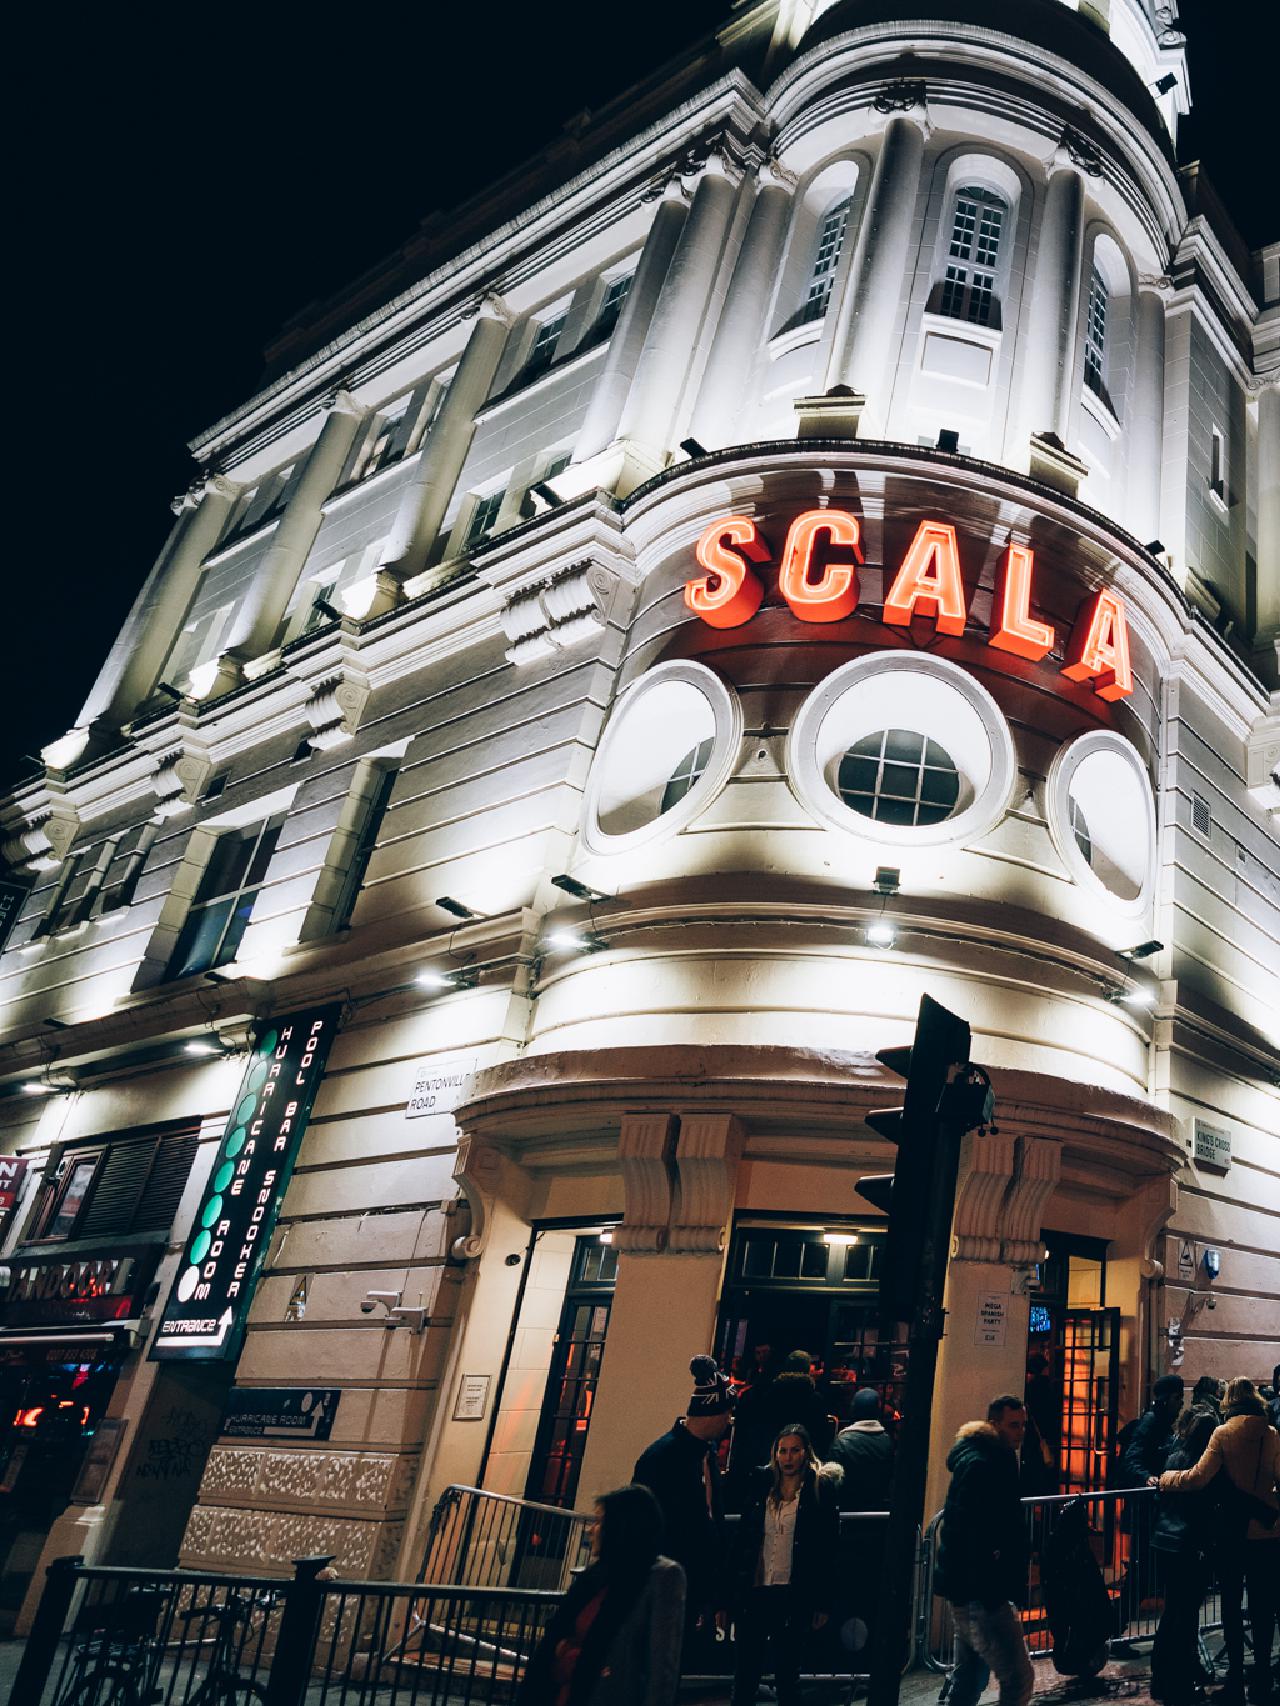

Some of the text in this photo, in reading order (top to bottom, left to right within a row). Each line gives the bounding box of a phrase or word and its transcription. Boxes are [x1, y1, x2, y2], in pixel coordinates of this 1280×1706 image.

[683, 508, 1134, 702] SCALA
[410, 1095, 436, 1110] ROAD
[227, 1020, 323, 1298] POOL BAR SNOOKER
[1196, 1143, 1215, 1160] BRIDGE
[194, 1026, 293, 1300] HURRICANE ROOM
[162, 1318, 217, 1333] ENTRANCE
[230, 1413, 307, 1426] HURRICANE ROOM
